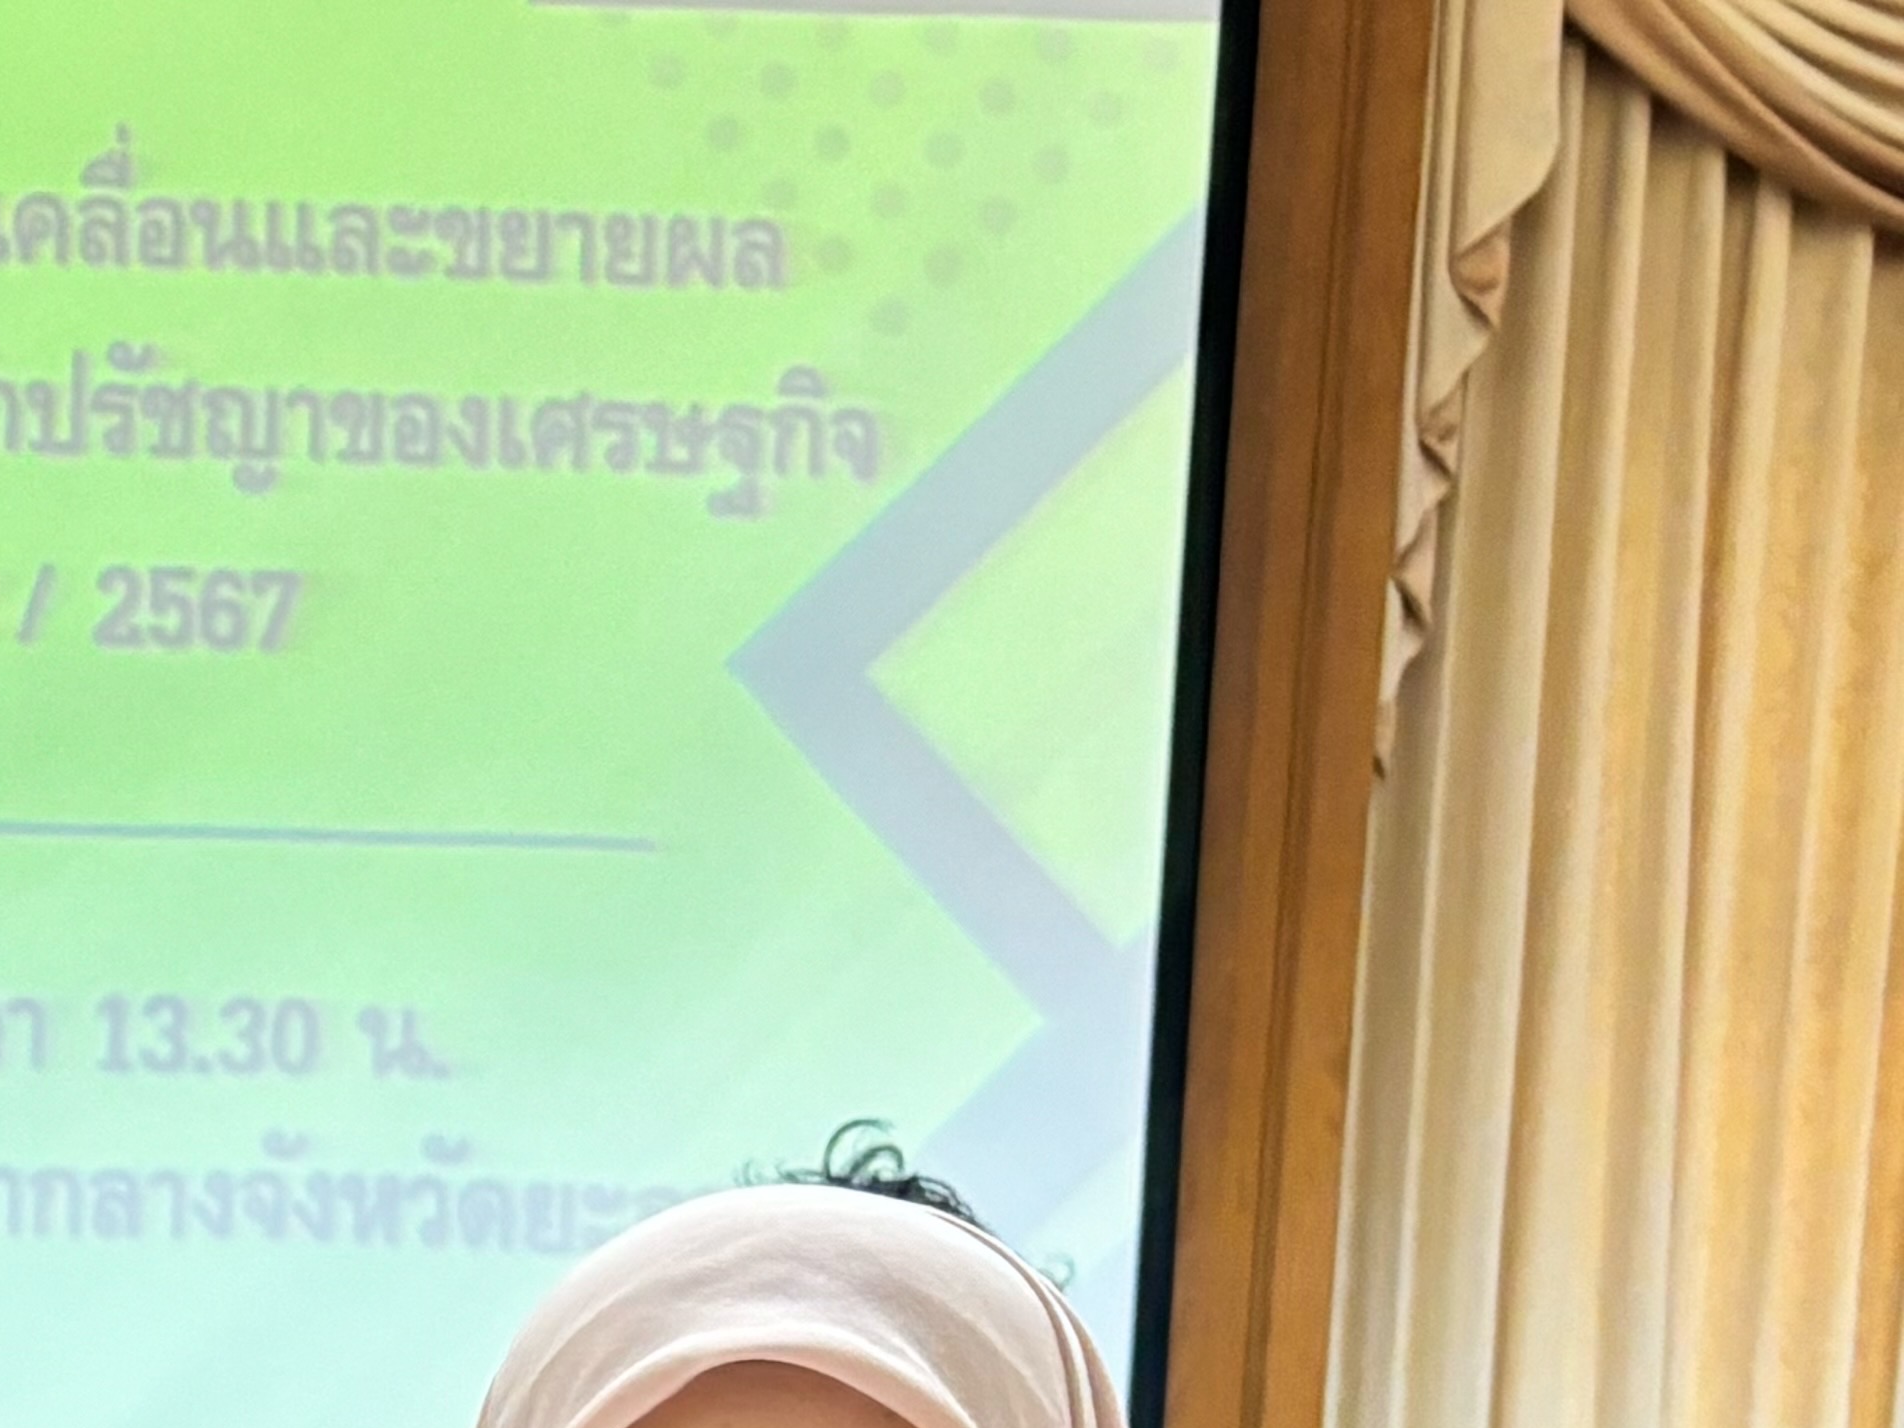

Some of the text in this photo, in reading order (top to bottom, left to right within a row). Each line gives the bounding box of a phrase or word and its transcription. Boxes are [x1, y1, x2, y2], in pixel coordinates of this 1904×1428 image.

[14, 562, 57, 646] /
[90, 564, 306, 653] 2567
[97, 993, 320, 1075] 13.30
[357, 1005, 452, 1079] น.
